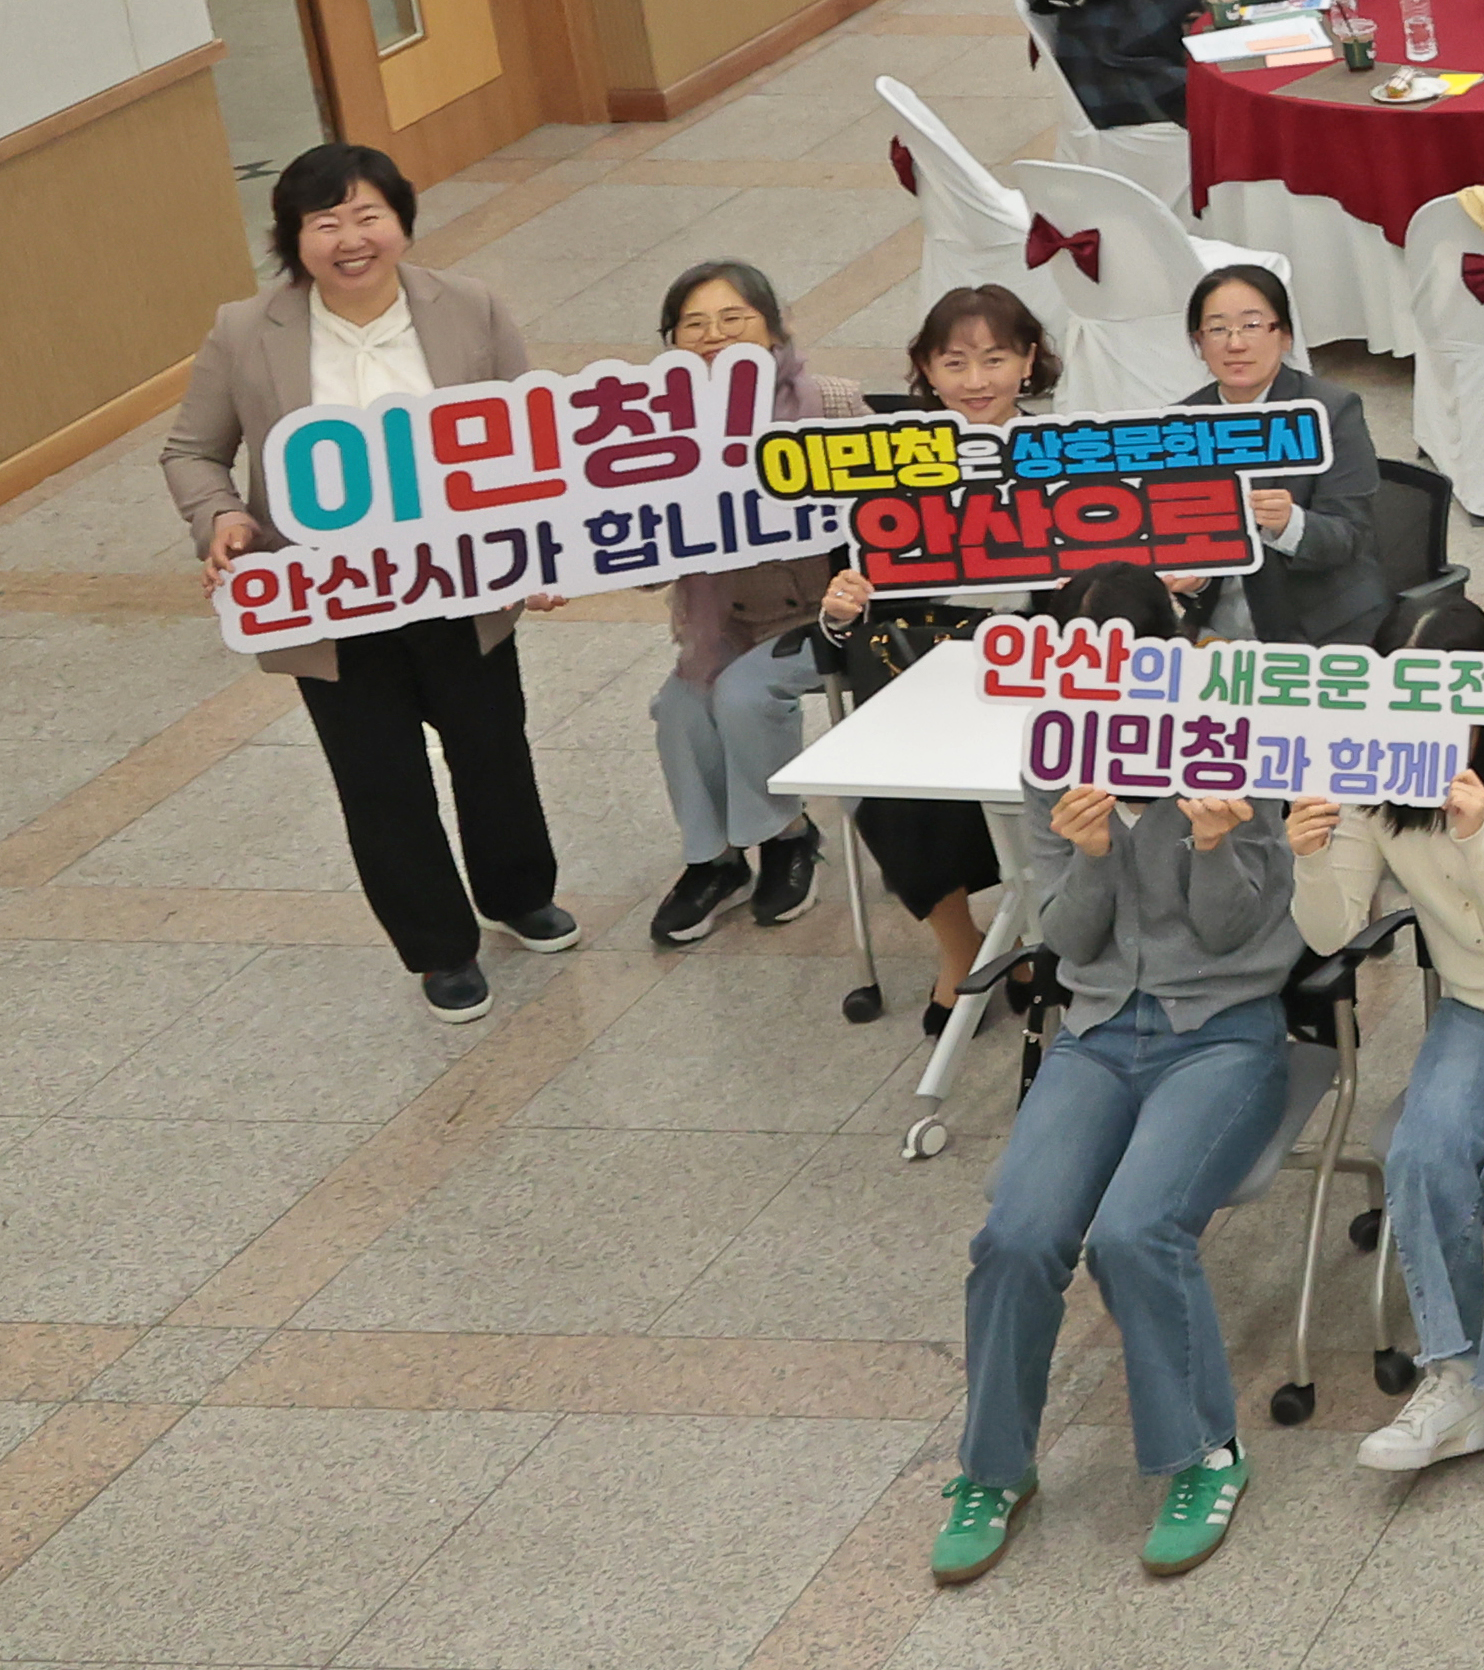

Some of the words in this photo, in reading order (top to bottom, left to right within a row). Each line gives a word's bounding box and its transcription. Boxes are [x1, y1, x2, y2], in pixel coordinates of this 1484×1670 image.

[283, 359, 759, 532] 이민청!
[763, 426, 1003, 495] 이민청은
[1012, 415, 1319, 479] 상호문화도시
[230, 520, 563, 637] 안산시가
[854, 478, 1248, 586] 안산으로
[982, 624, 1182, 703] 안산의
[1199, 649, 1370, 711] 새로운
[1029, 709, 1311, 792] 이민청과
[1328, 736, 1459, 798] 함께!
